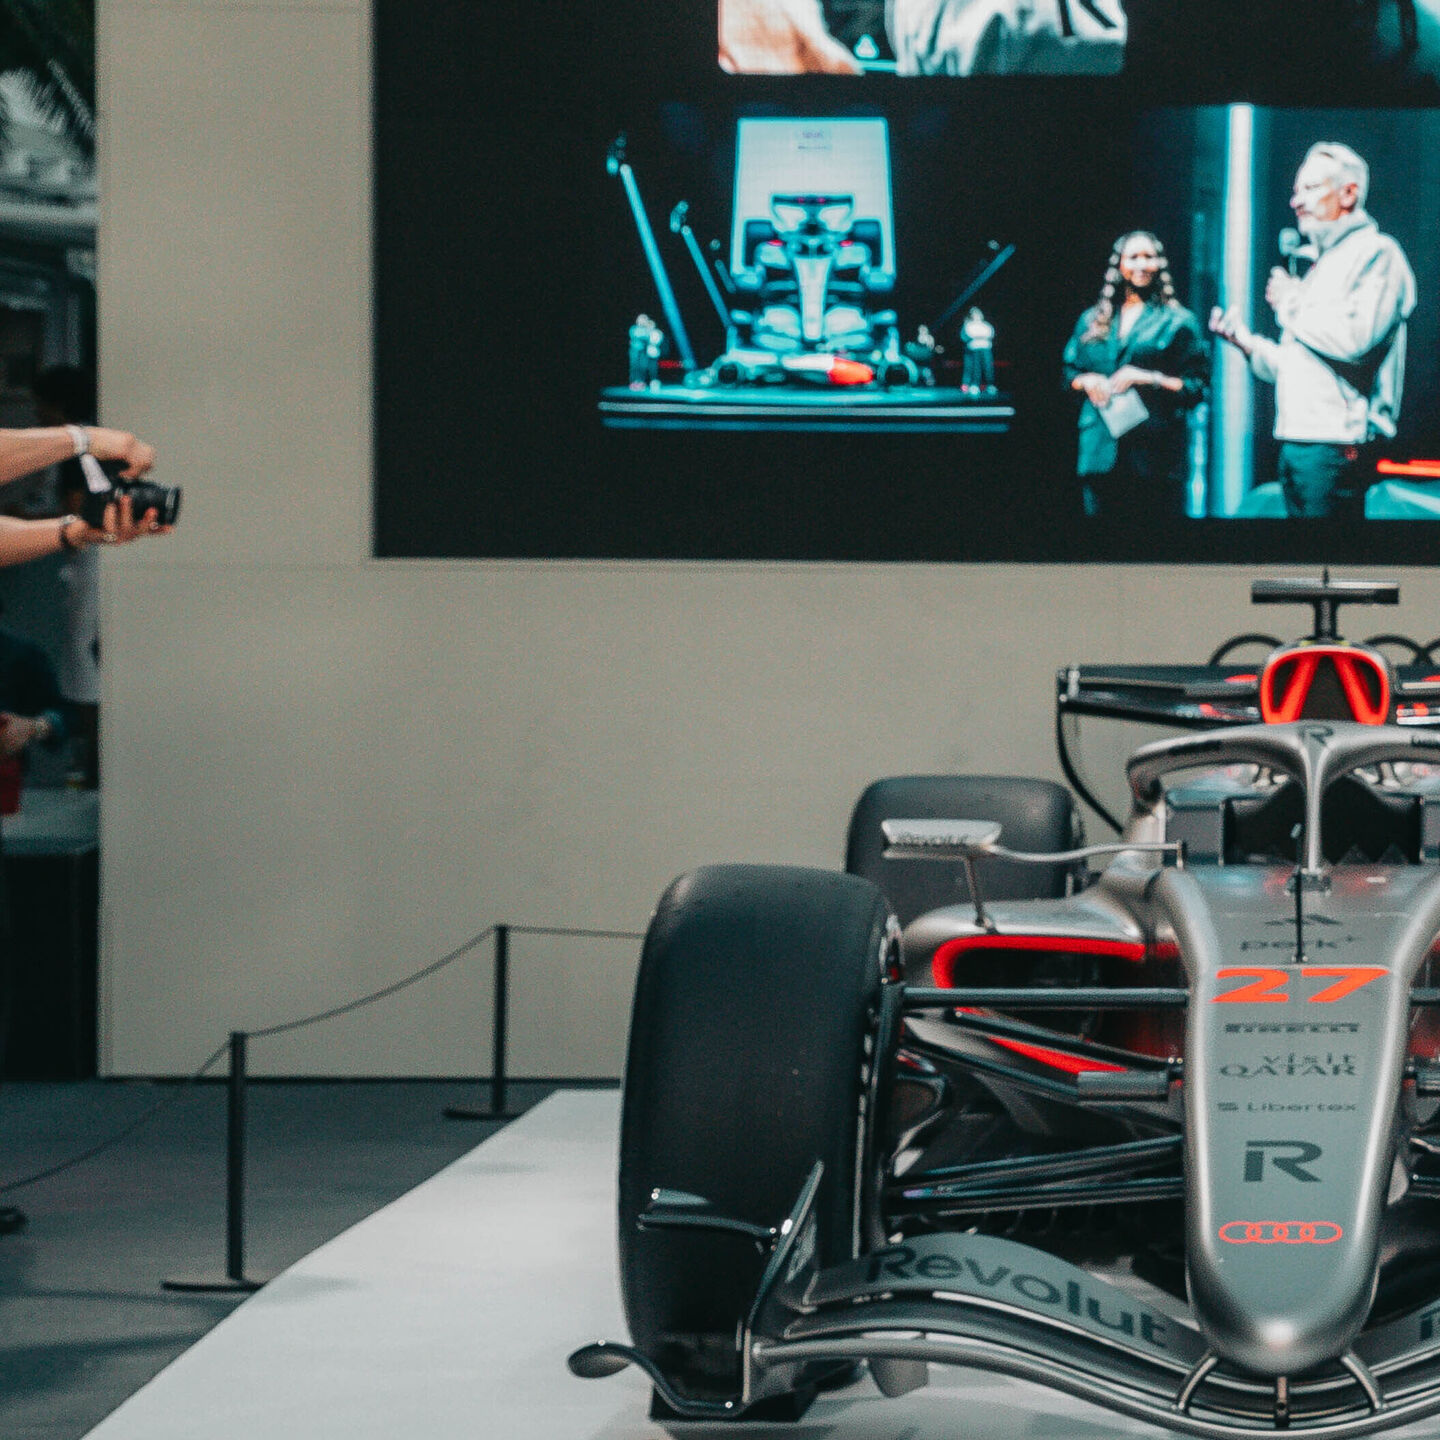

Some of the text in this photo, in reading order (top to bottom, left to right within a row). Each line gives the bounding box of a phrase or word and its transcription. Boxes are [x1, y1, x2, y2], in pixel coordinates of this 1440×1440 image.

[1210, 967, 1390, 1004] 27
[1220, 1064, 1356, 1077] QATAR
[1243, 1140, 1322, 1183] R
[865, 1245, 1168, 1349] Revolut
